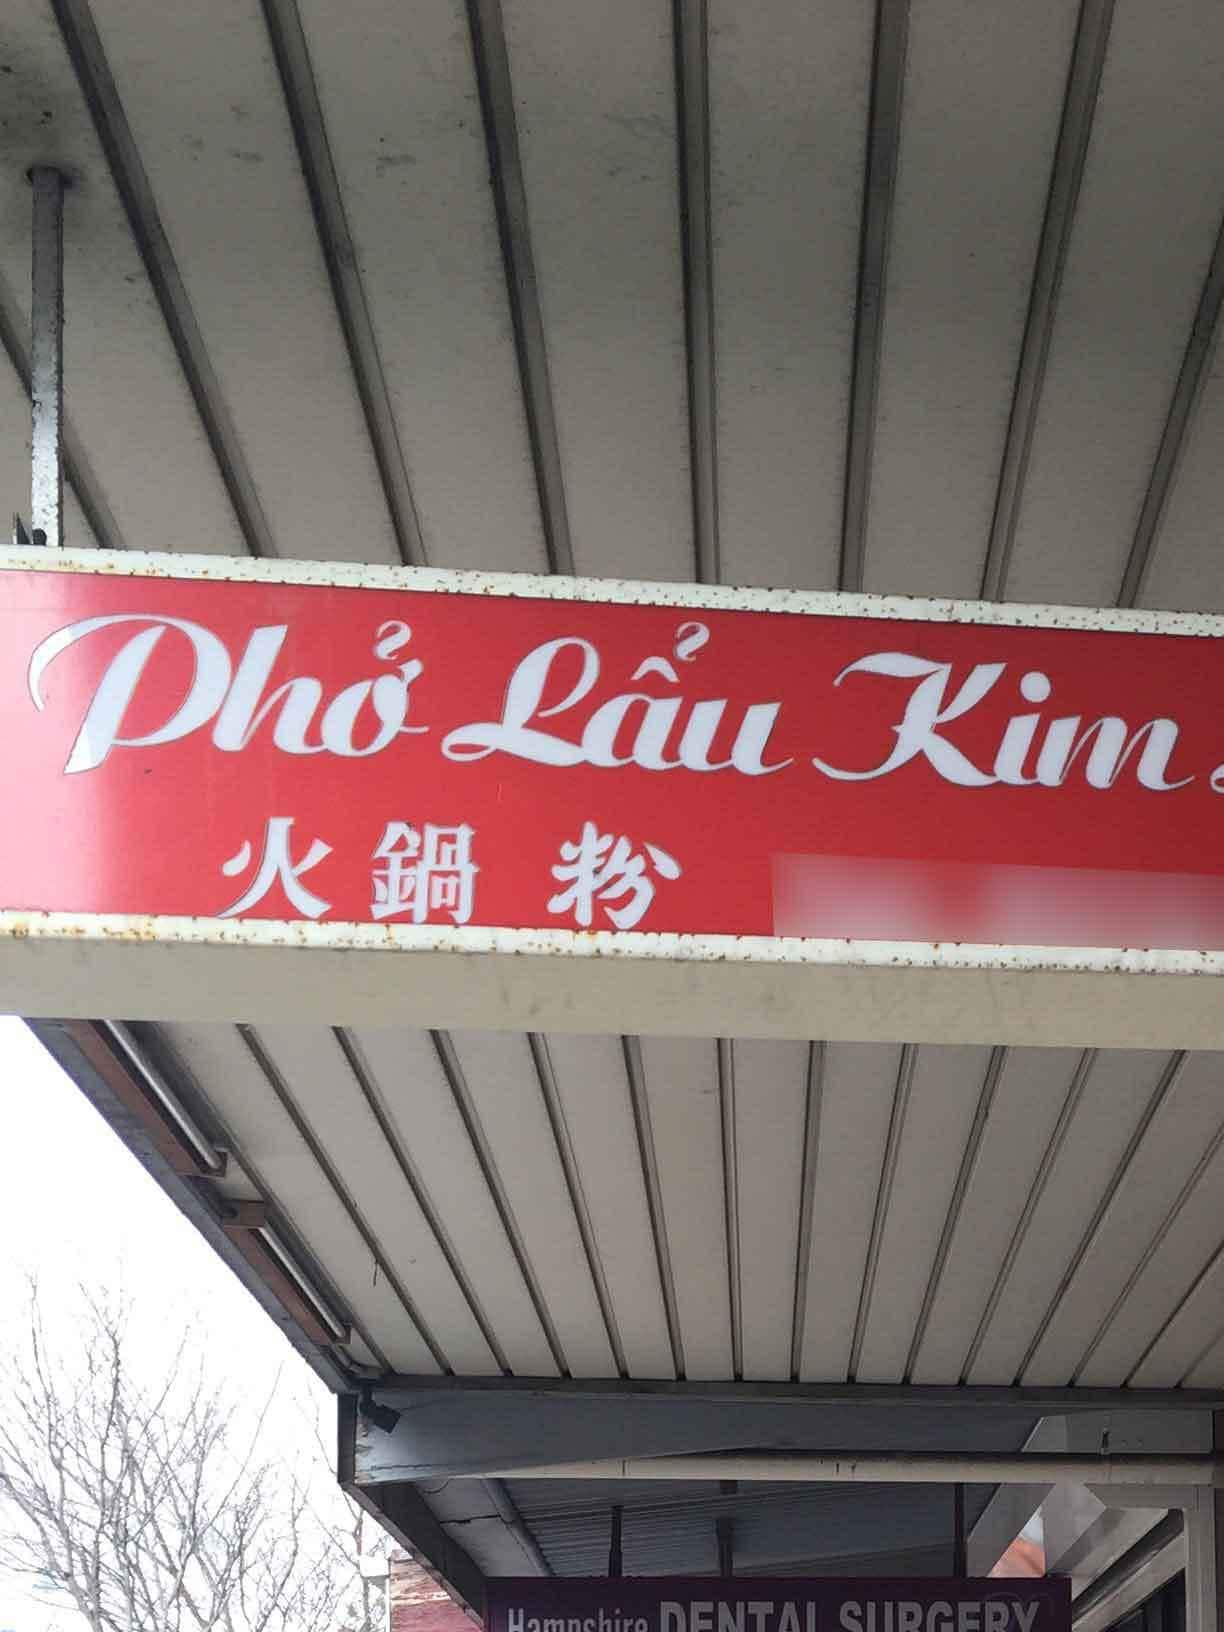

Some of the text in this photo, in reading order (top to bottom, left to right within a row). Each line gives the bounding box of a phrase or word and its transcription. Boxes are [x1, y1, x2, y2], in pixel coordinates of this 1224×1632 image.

[27, 612, 430, 776] Phở
[440, 621, 795, 777] Lẩu
[812, 650, 1196, 790] Kim
